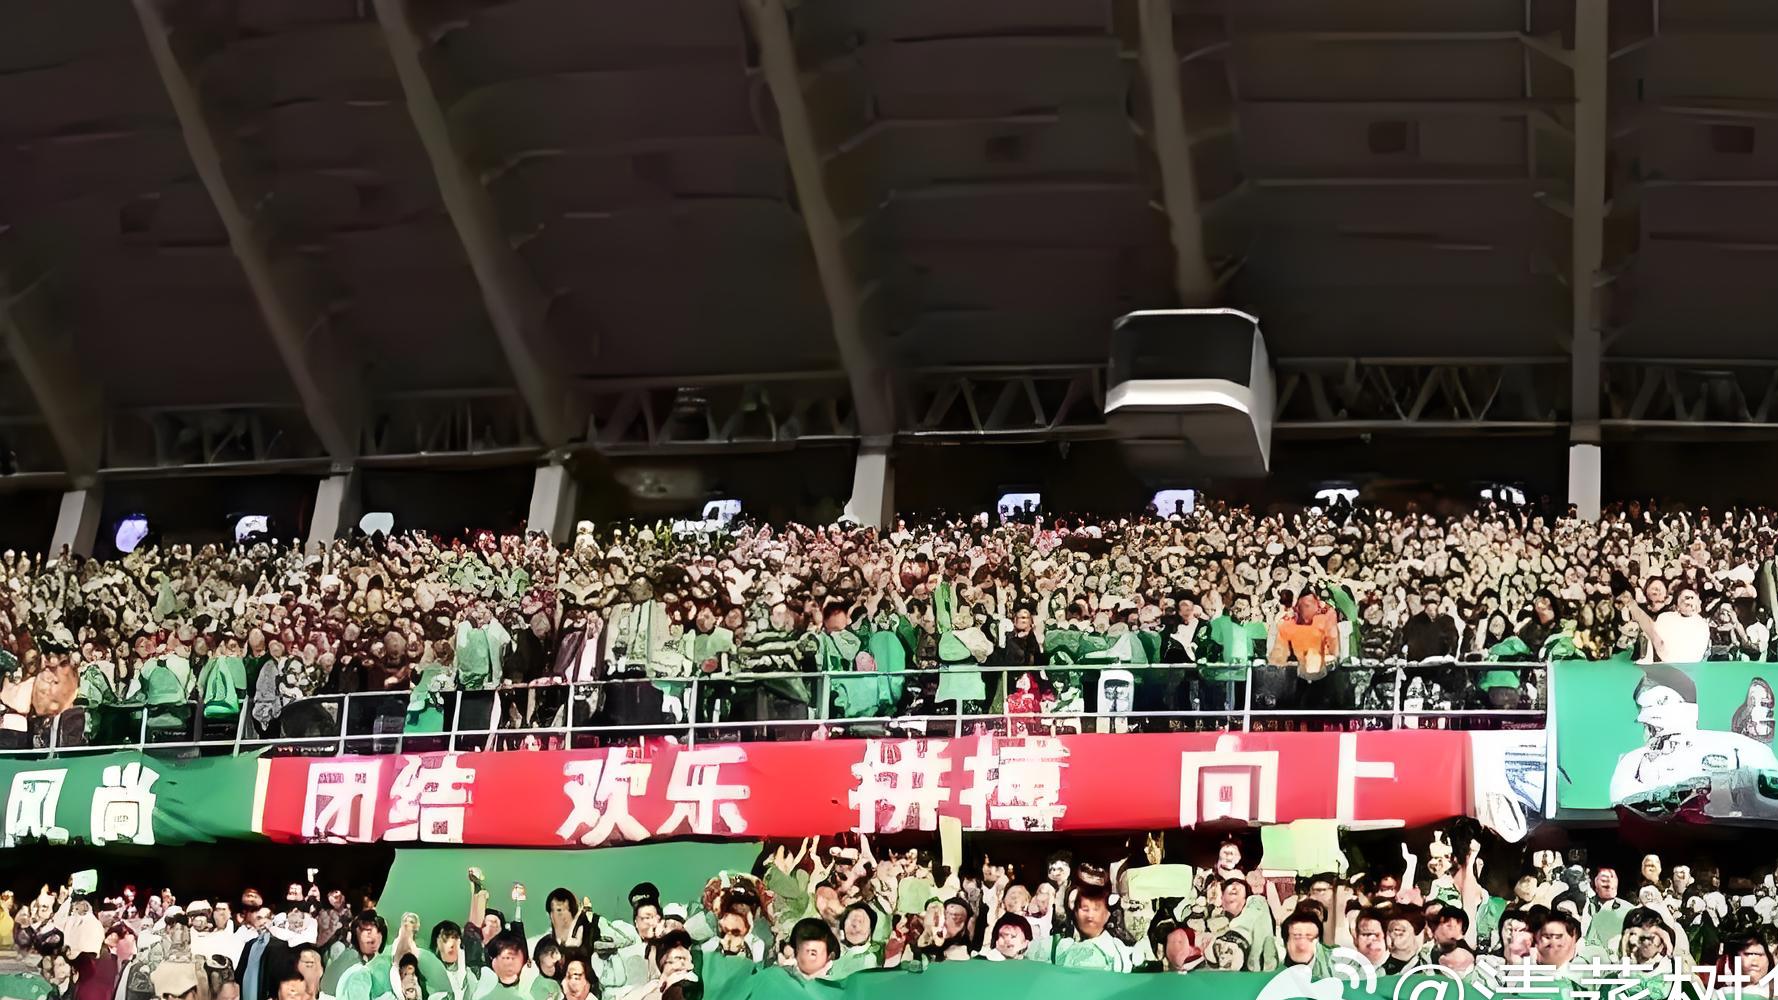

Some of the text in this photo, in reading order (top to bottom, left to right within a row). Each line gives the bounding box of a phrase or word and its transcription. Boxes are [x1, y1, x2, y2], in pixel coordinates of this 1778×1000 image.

[4, 761, 160, 848] 风尚
[301, 750, 474, 845] 团结
[557, 745, 751, 845] 欢乐
[1179, 733, 1406, 830] 向上
